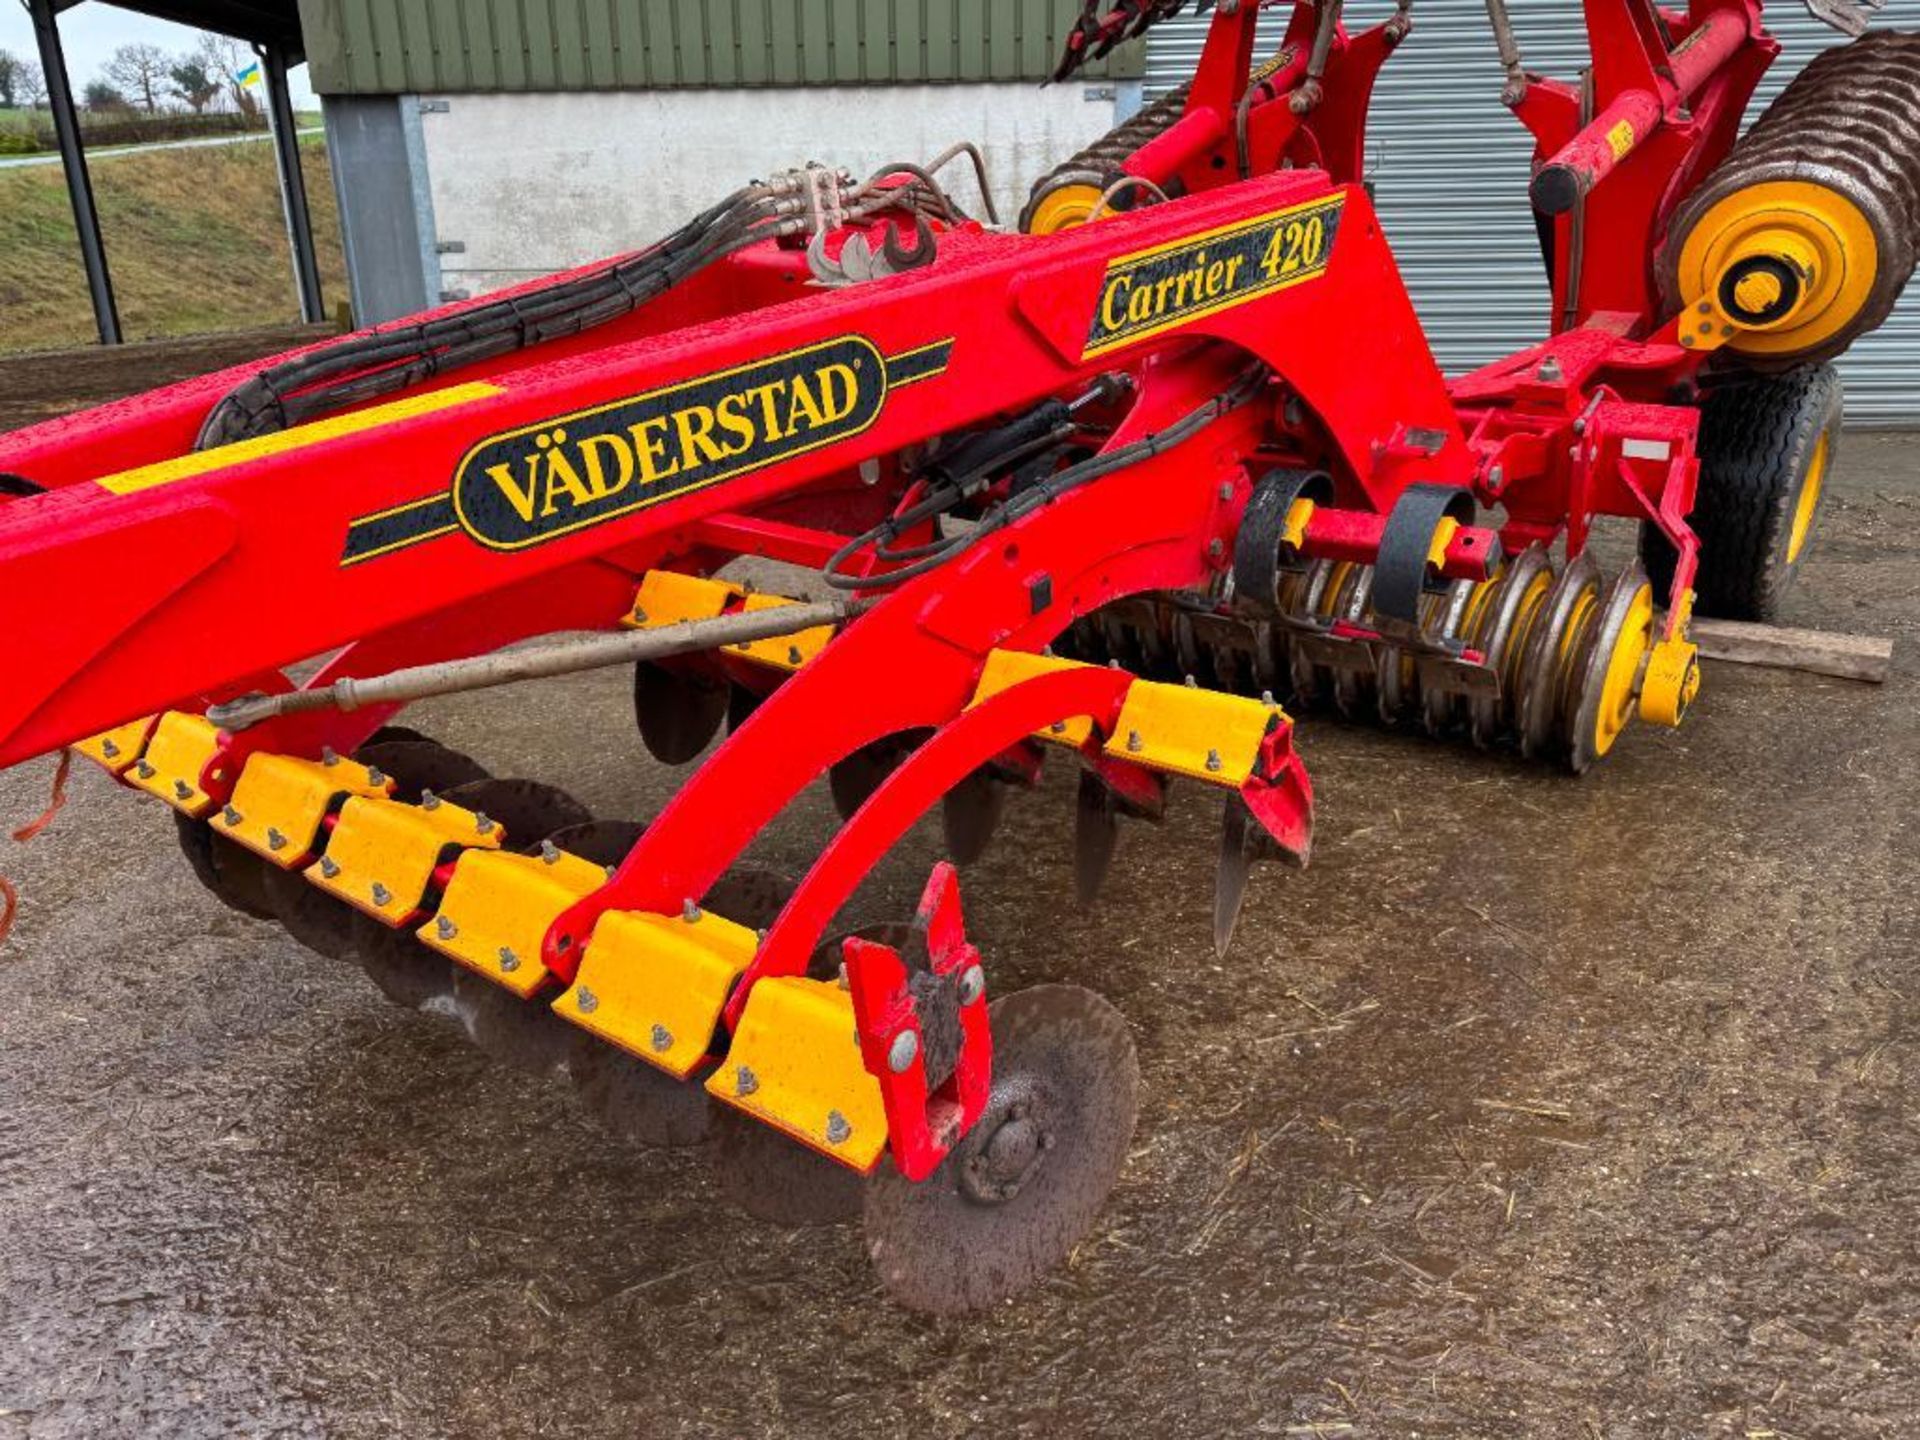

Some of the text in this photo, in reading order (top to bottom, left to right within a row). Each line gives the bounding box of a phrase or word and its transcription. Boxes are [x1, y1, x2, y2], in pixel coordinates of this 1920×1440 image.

[1102, 216, 1323, 331] Carrier 420
[486, 364, 859, 523] VÄDERSTAD
